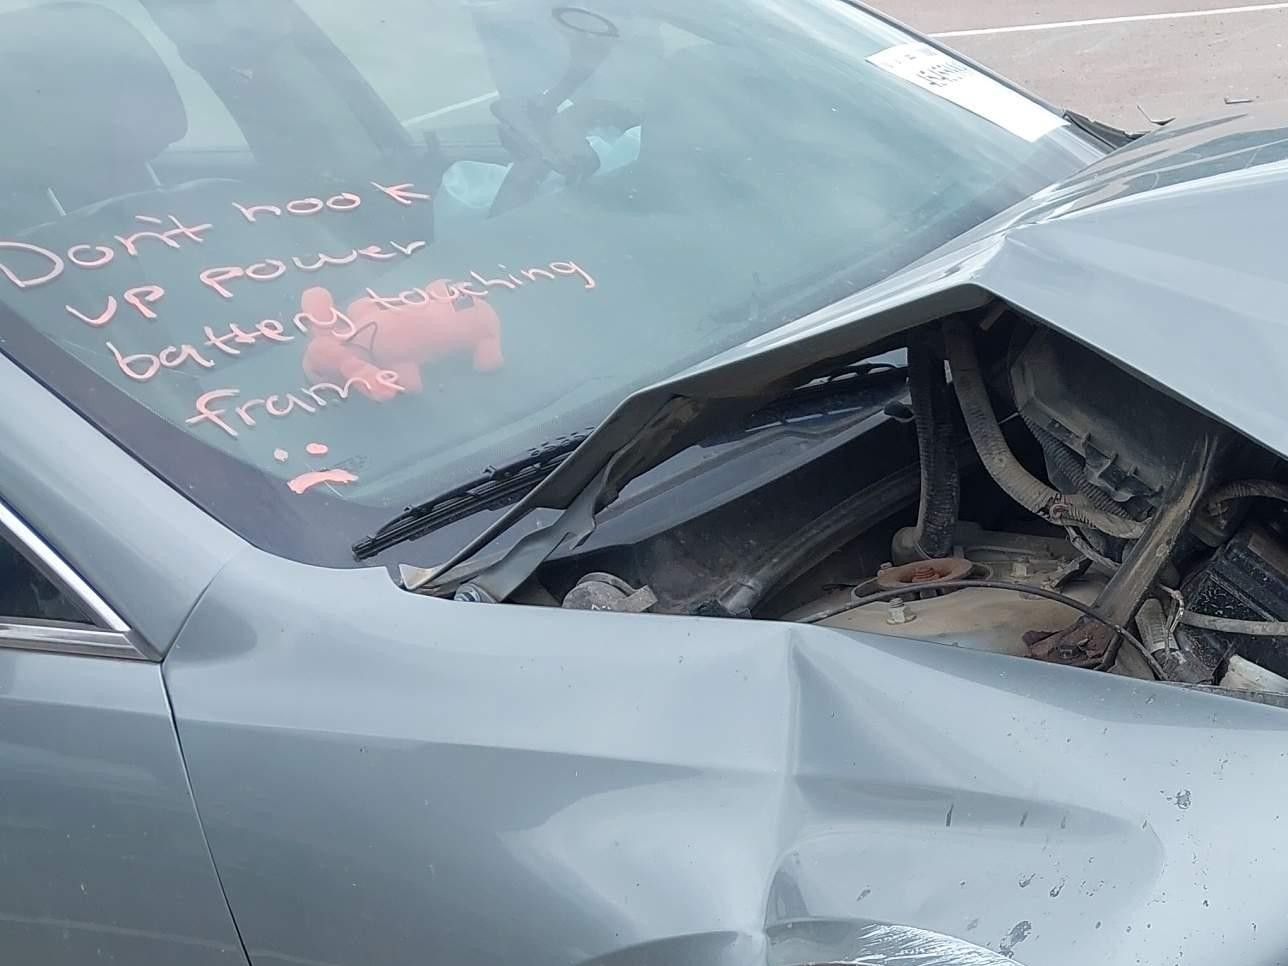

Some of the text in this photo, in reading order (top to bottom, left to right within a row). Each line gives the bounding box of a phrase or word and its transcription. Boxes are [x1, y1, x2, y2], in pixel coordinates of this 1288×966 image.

[0, 180, 430, 288] Don't hook
[200, 240, 426, 298] power
[106, 259, 596, 382] battery touching
[186, 369, 405, 436] frame
